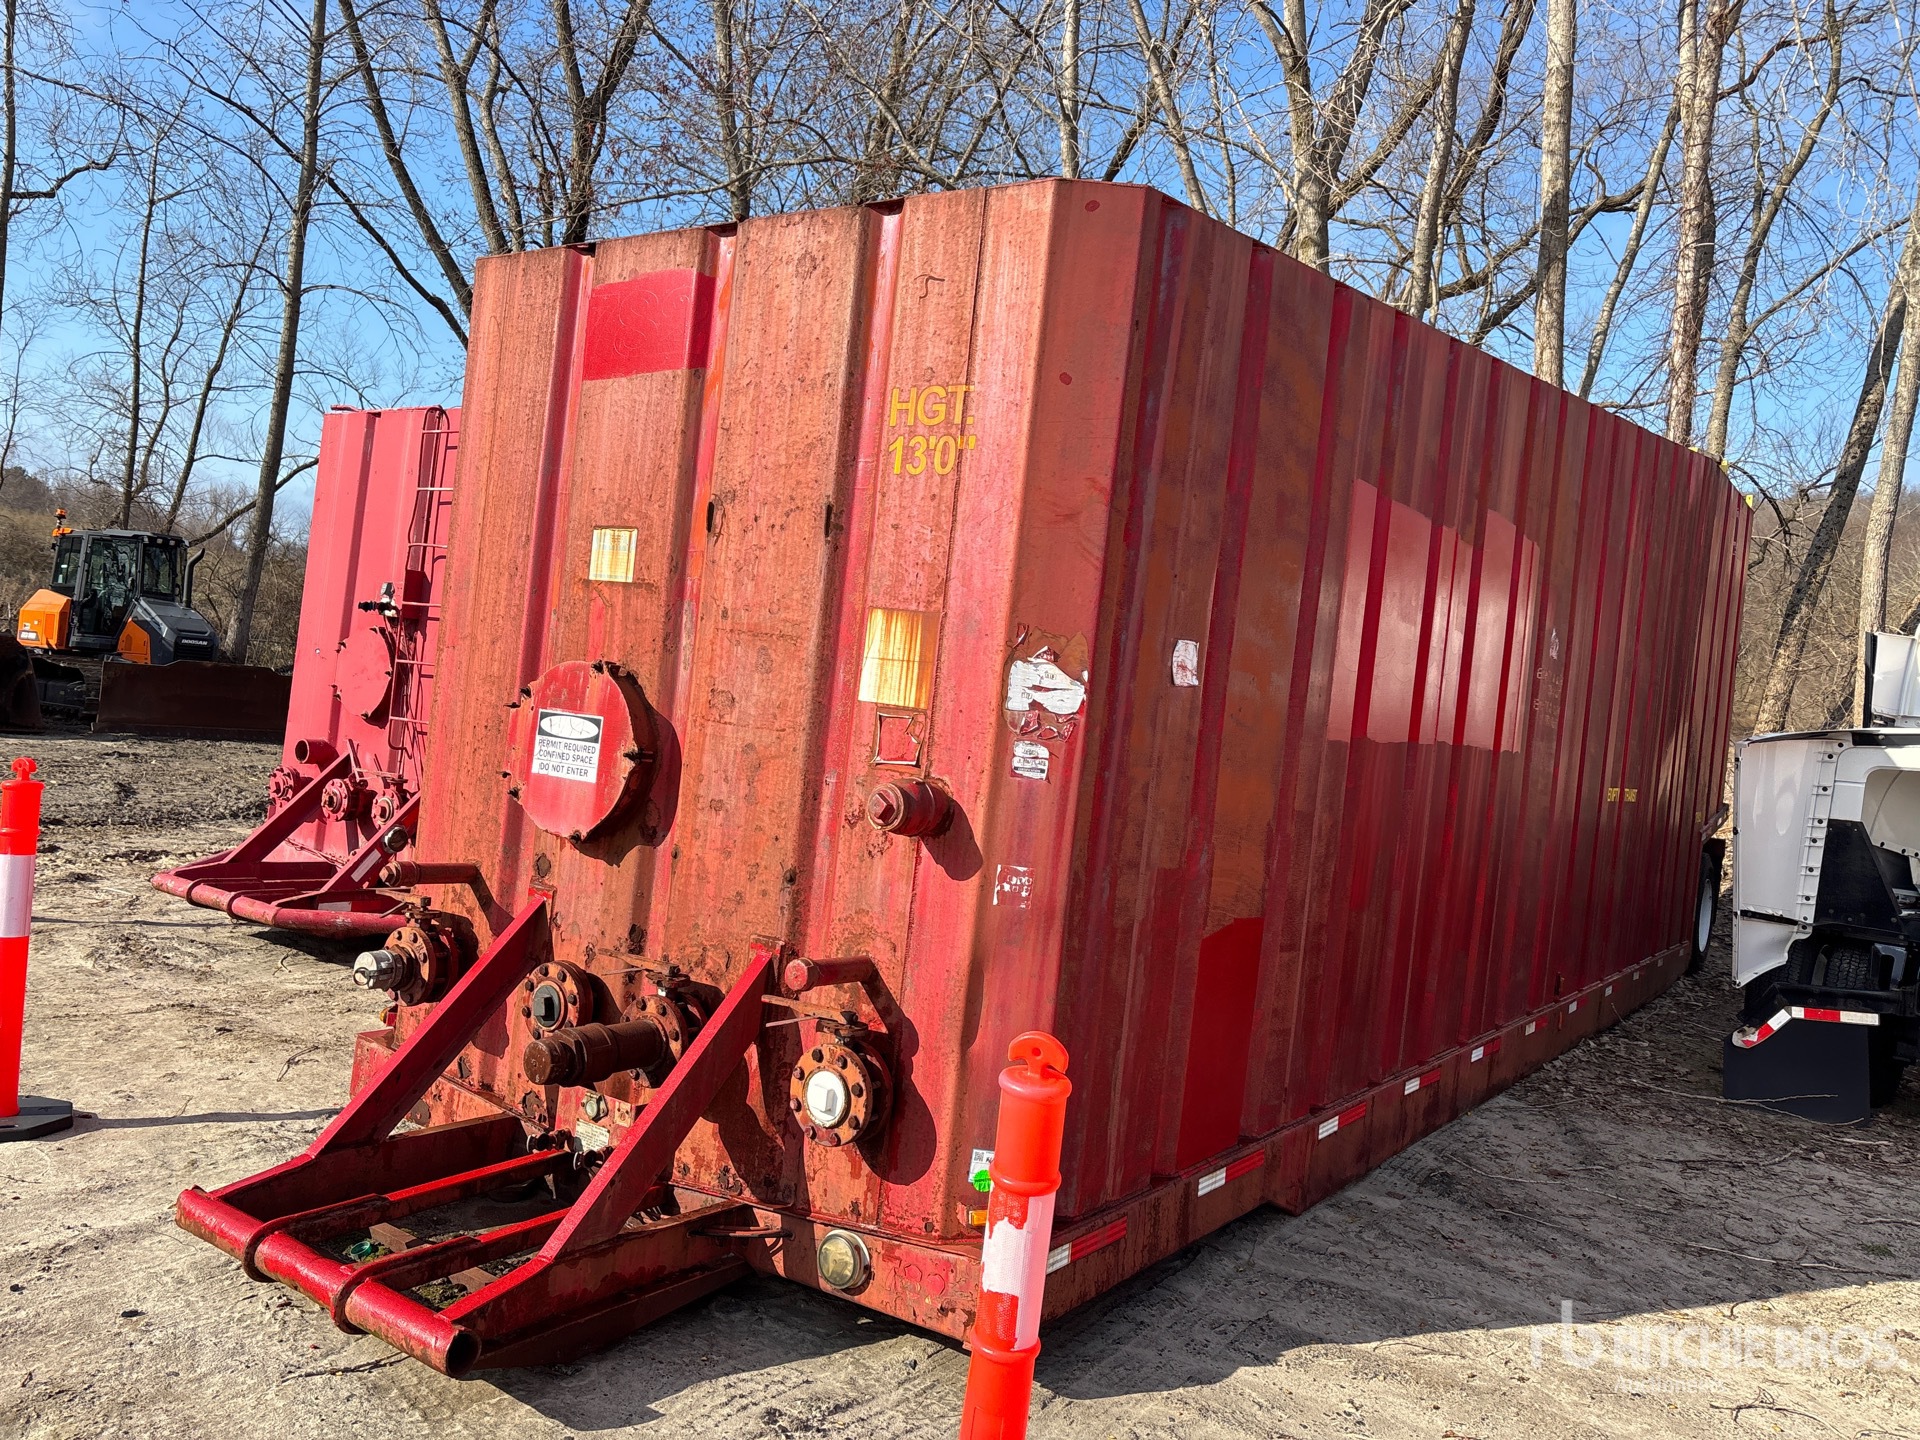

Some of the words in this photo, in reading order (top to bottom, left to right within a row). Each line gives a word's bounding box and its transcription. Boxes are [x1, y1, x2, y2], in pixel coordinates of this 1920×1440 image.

[889, 385, 975, 427] HGT.
[889, 435, 976, 475] 13'0"
[538, 739, 562, 750] PERMIT
[563, 742, 596, 754] REQUIRED
[538, 749, 570, 761] CONFINED
[572, 754, 593, 765] SPACE
[539, 762, 549, 771] DO
[552, 764, 564, 773] NOT
[566, 766, 589, 777] ENTER
